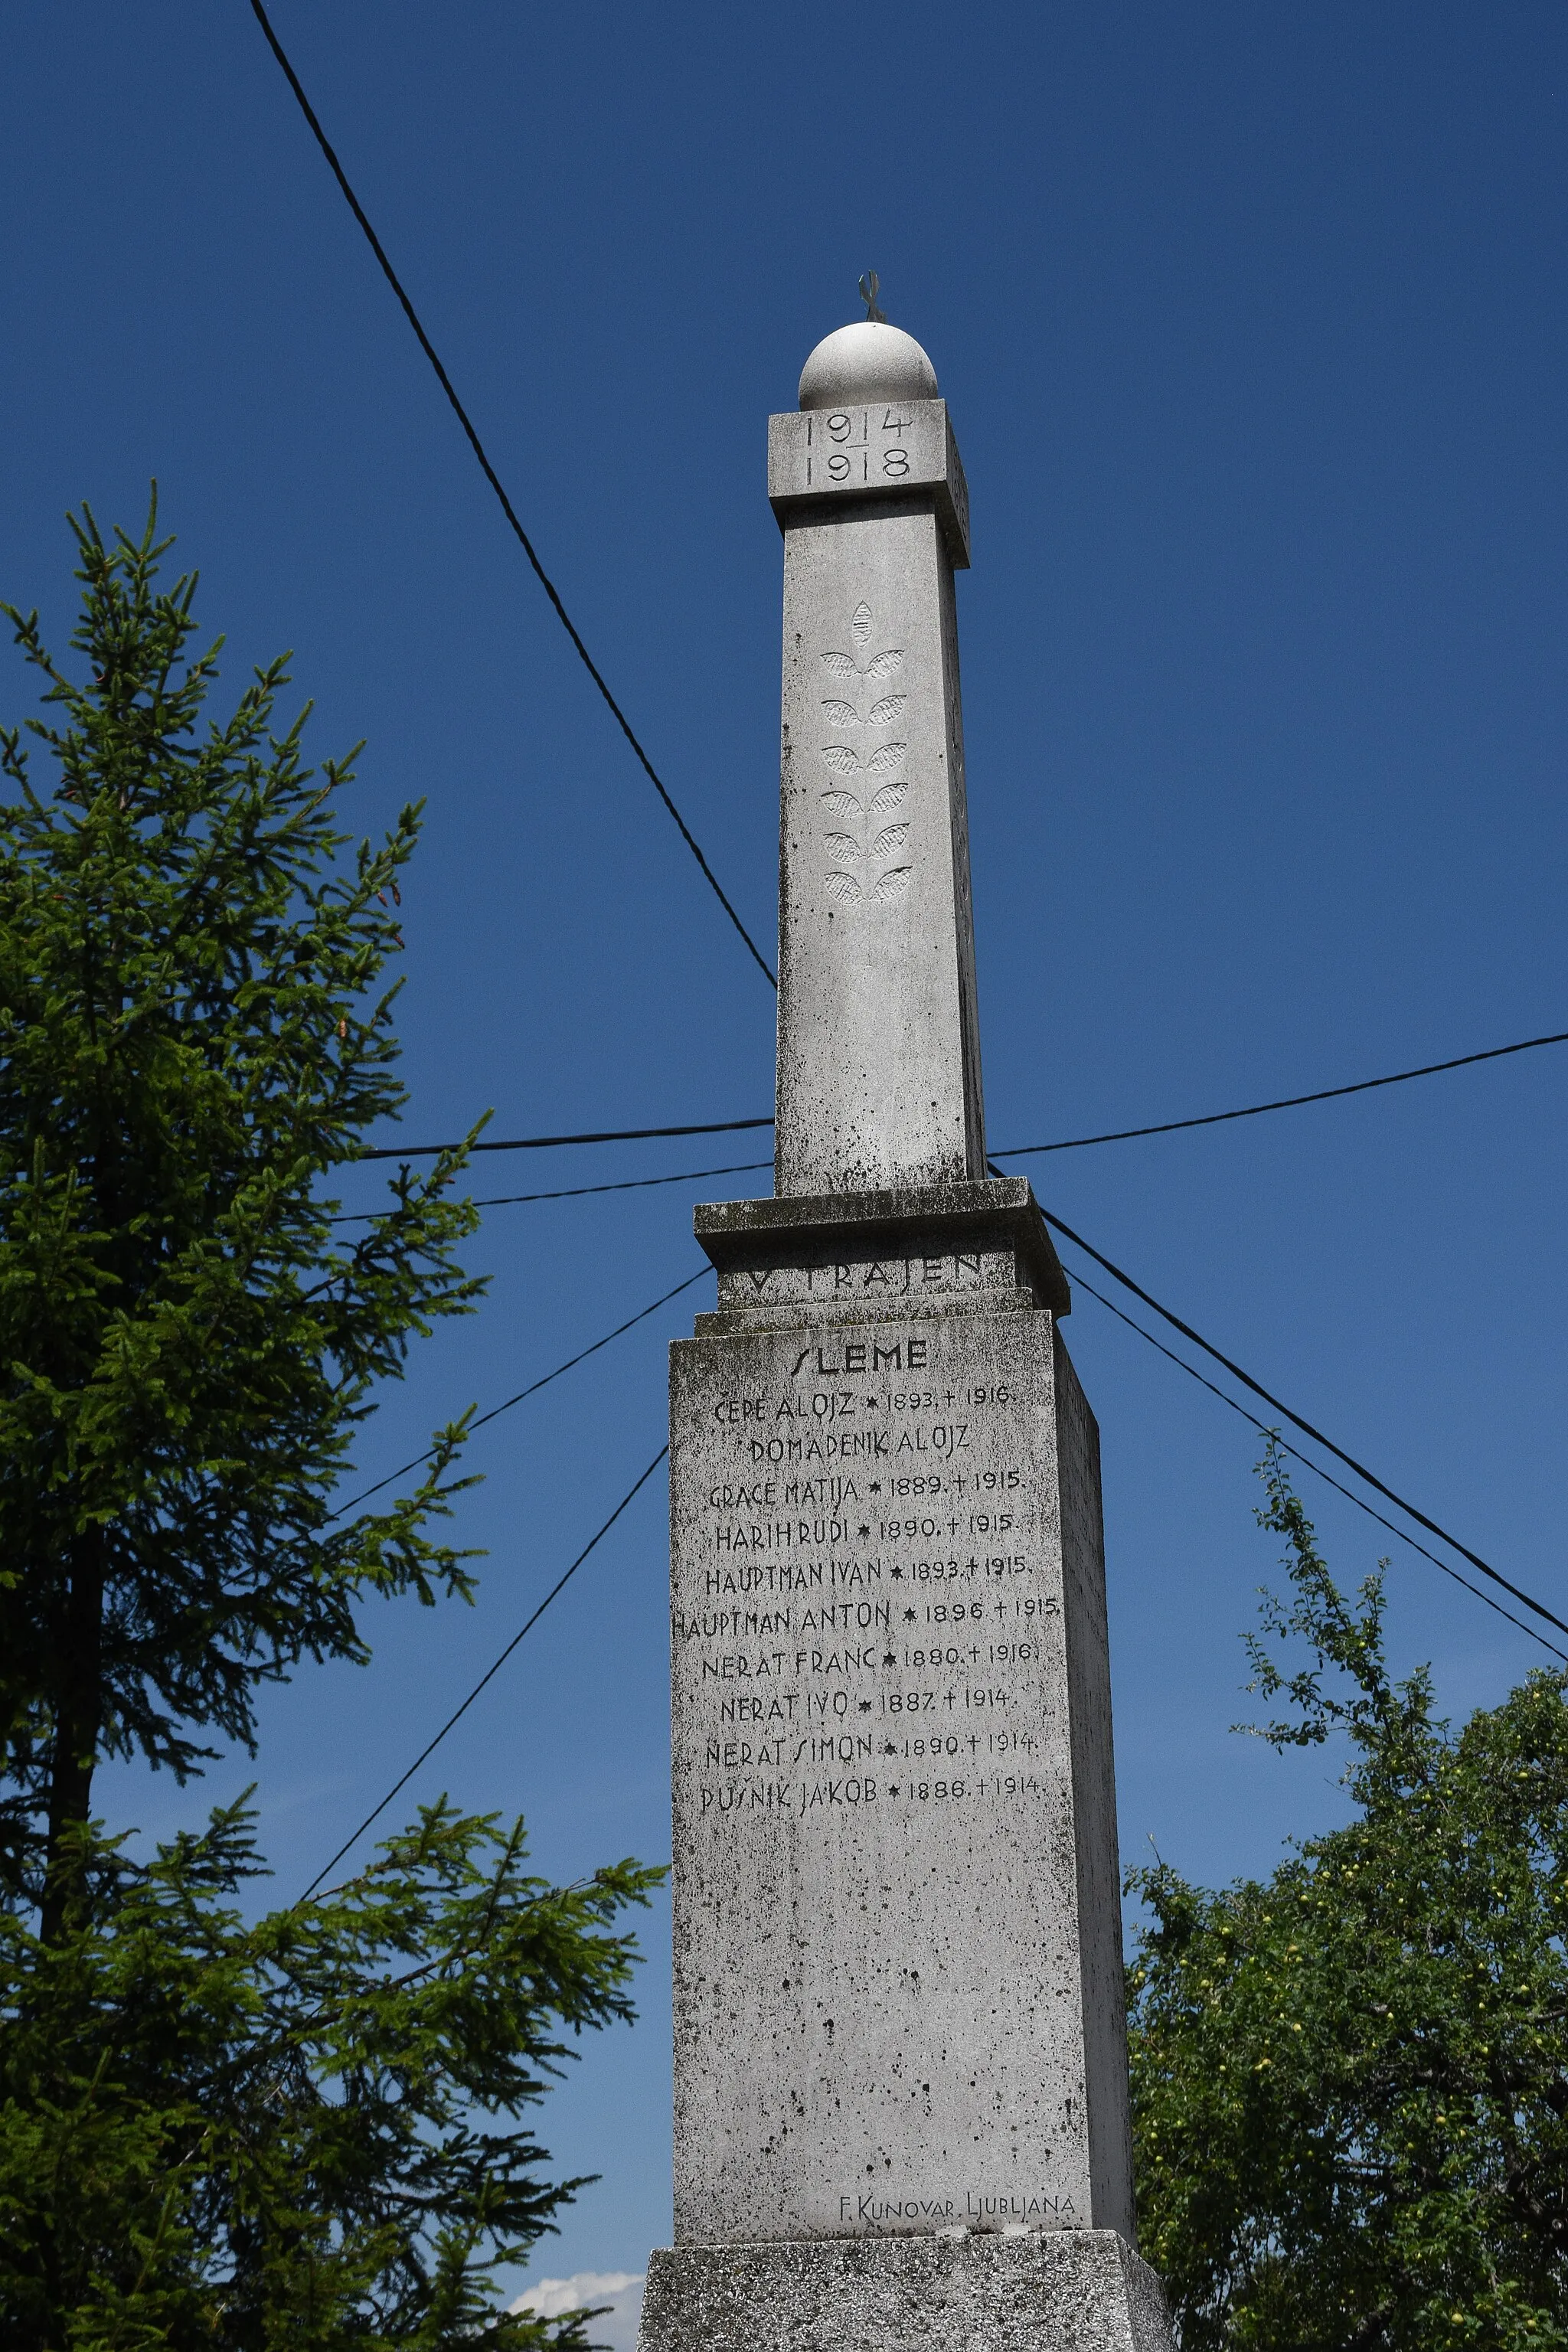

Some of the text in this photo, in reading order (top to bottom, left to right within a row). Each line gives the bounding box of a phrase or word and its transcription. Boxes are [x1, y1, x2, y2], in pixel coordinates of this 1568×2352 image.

[807, 409, 914, 446] 1914
[807, 448, 910, 485] 1918
[749, 1253, 981, 1296] V TRAJEN
[791, 1337, 927, 1377] SLEME
[776, 1392, 855, 1422] ALOJZ
[751, 1425, 970, 1462] DOMADENIK ALOJZ
[785, 1476, 859, 1507] MATIJA
[717, 1522, 792, 1551] HARIH
[799, 1519, 848, 1544] RUDI
[706, 1563, 823, 1595] HAUPTMAN
[831, 1559, 881, 1586] IVAN
[671, 1609, 791, 1640] HAUPTMAN
[802, 1601, 890, 1631] ANTON
[926, 1602, 984, 1623] 1896
[703, 1653, 786, 1679] NERAT
[795, 1647, 876, 1674] FRANC
[720, 1694, 799, 1723] NERAT
[808, 1691, 848, 1718] IVO
[707, 1740, 786, 1769] NERAT
[794, 1734, 873, 1763] SIMON
[701, 1776, 791, 1812] PUŠNIK
[799, 1779, 877, 1818] JAKOB
[967, 2192, 1076, 2220] LJUBLJANA
